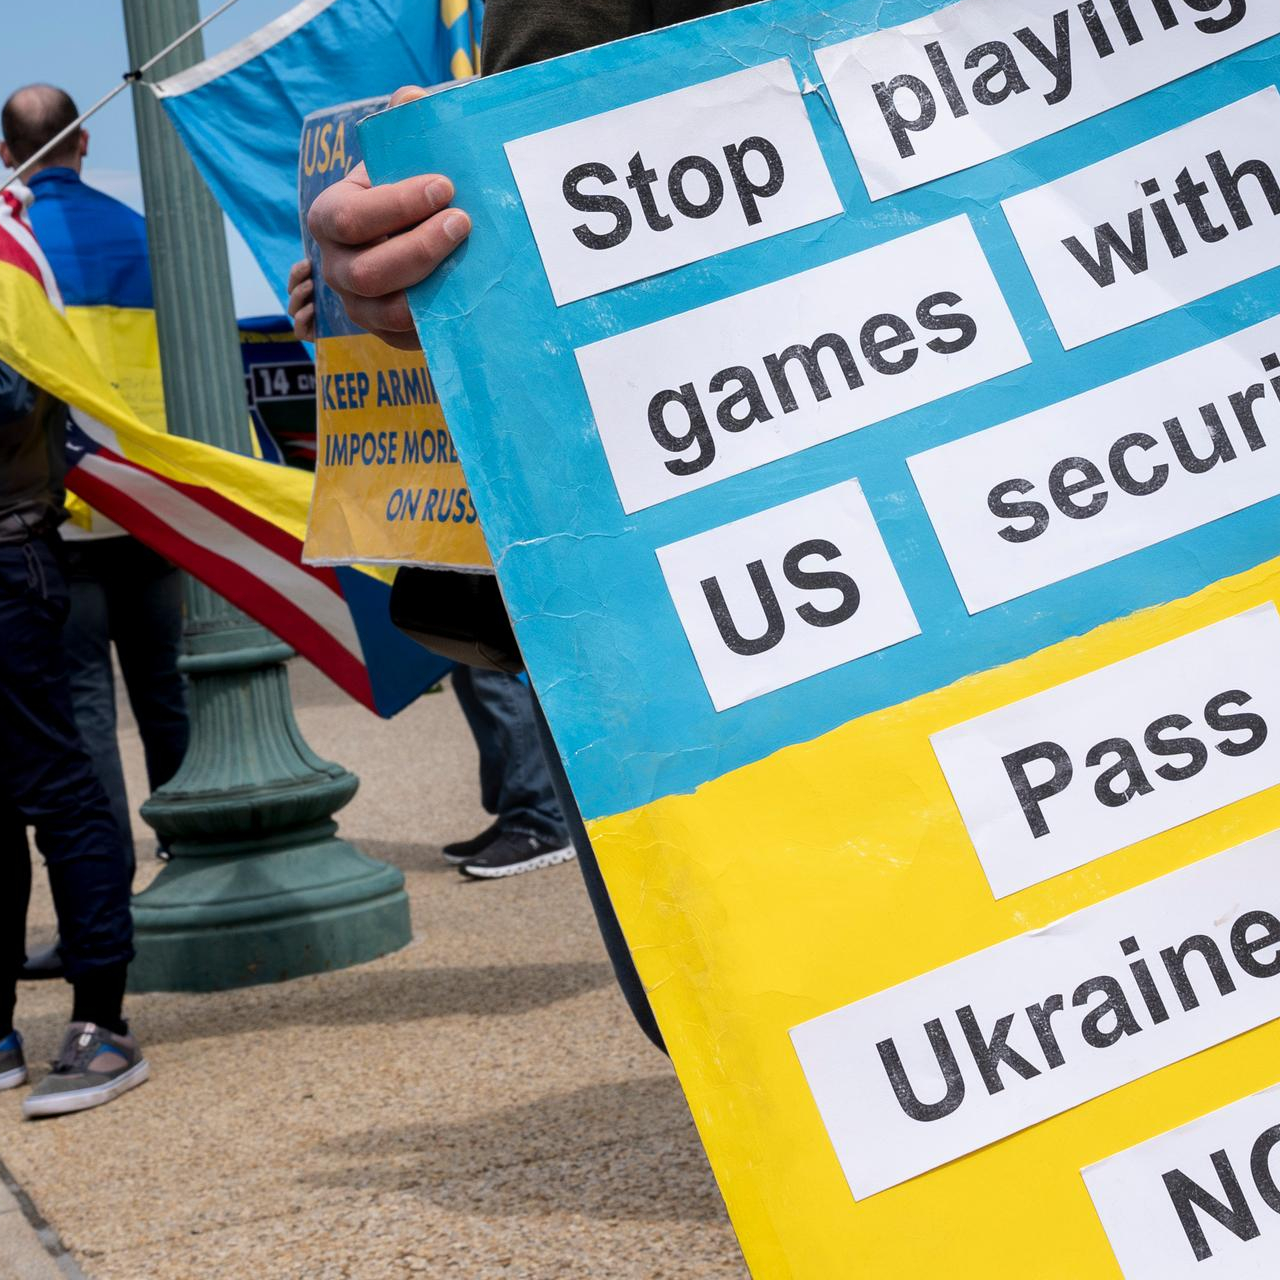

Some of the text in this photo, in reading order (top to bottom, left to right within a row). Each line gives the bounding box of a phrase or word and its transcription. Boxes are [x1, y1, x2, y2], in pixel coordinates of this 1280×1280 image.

[562, 136, 786, 251] Stop
[259, 368, 290, 396] 14
[321, 372, 370, 410] KEEP
[647, 291, 977, 477] games
[325, 431, 398, 466] IMPOSE
[386, 488, 422, 521] ON
[699, 539, 861, 657] US
[1001, 689, 1269, 840] Pass
